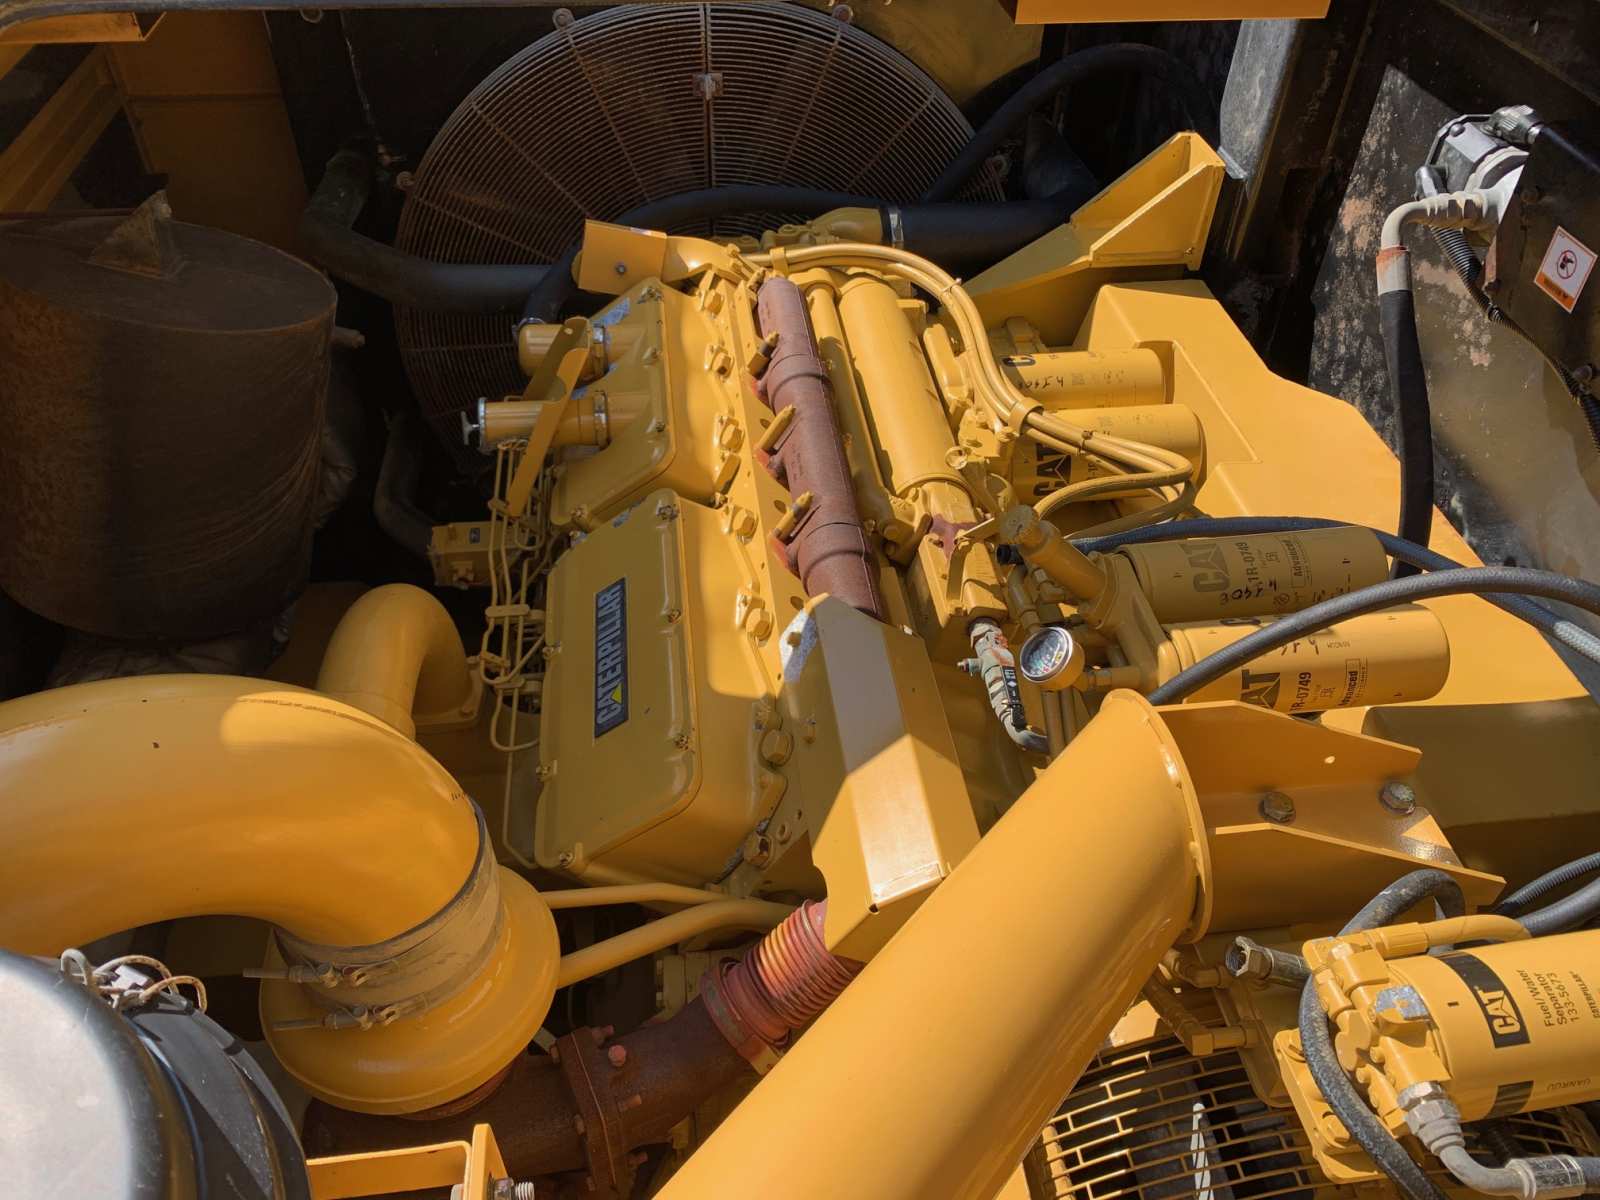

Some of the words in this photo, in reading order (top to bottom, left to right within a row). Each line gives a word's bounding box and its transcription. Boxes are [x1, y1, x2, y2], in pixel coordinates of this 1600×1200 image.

[1034, 443, 1071, 496] CAT
[1180, 543, 1230, 593] CAT
[1236, 541, 1258, 583] 1R-0749
[1284, 539, 1303, 577] Advanced
[596, 584, 622, 725] CATERPILLAR
[1240, 669, 1281, 711] AT
[1478, 989, 1521, 1035] CAT
[1516, 969, 1555, 1027] Fuel/Water
[1534, 972, 1568, 1025] Separator
[1547, 972, 1580, 1022] 133-5673
